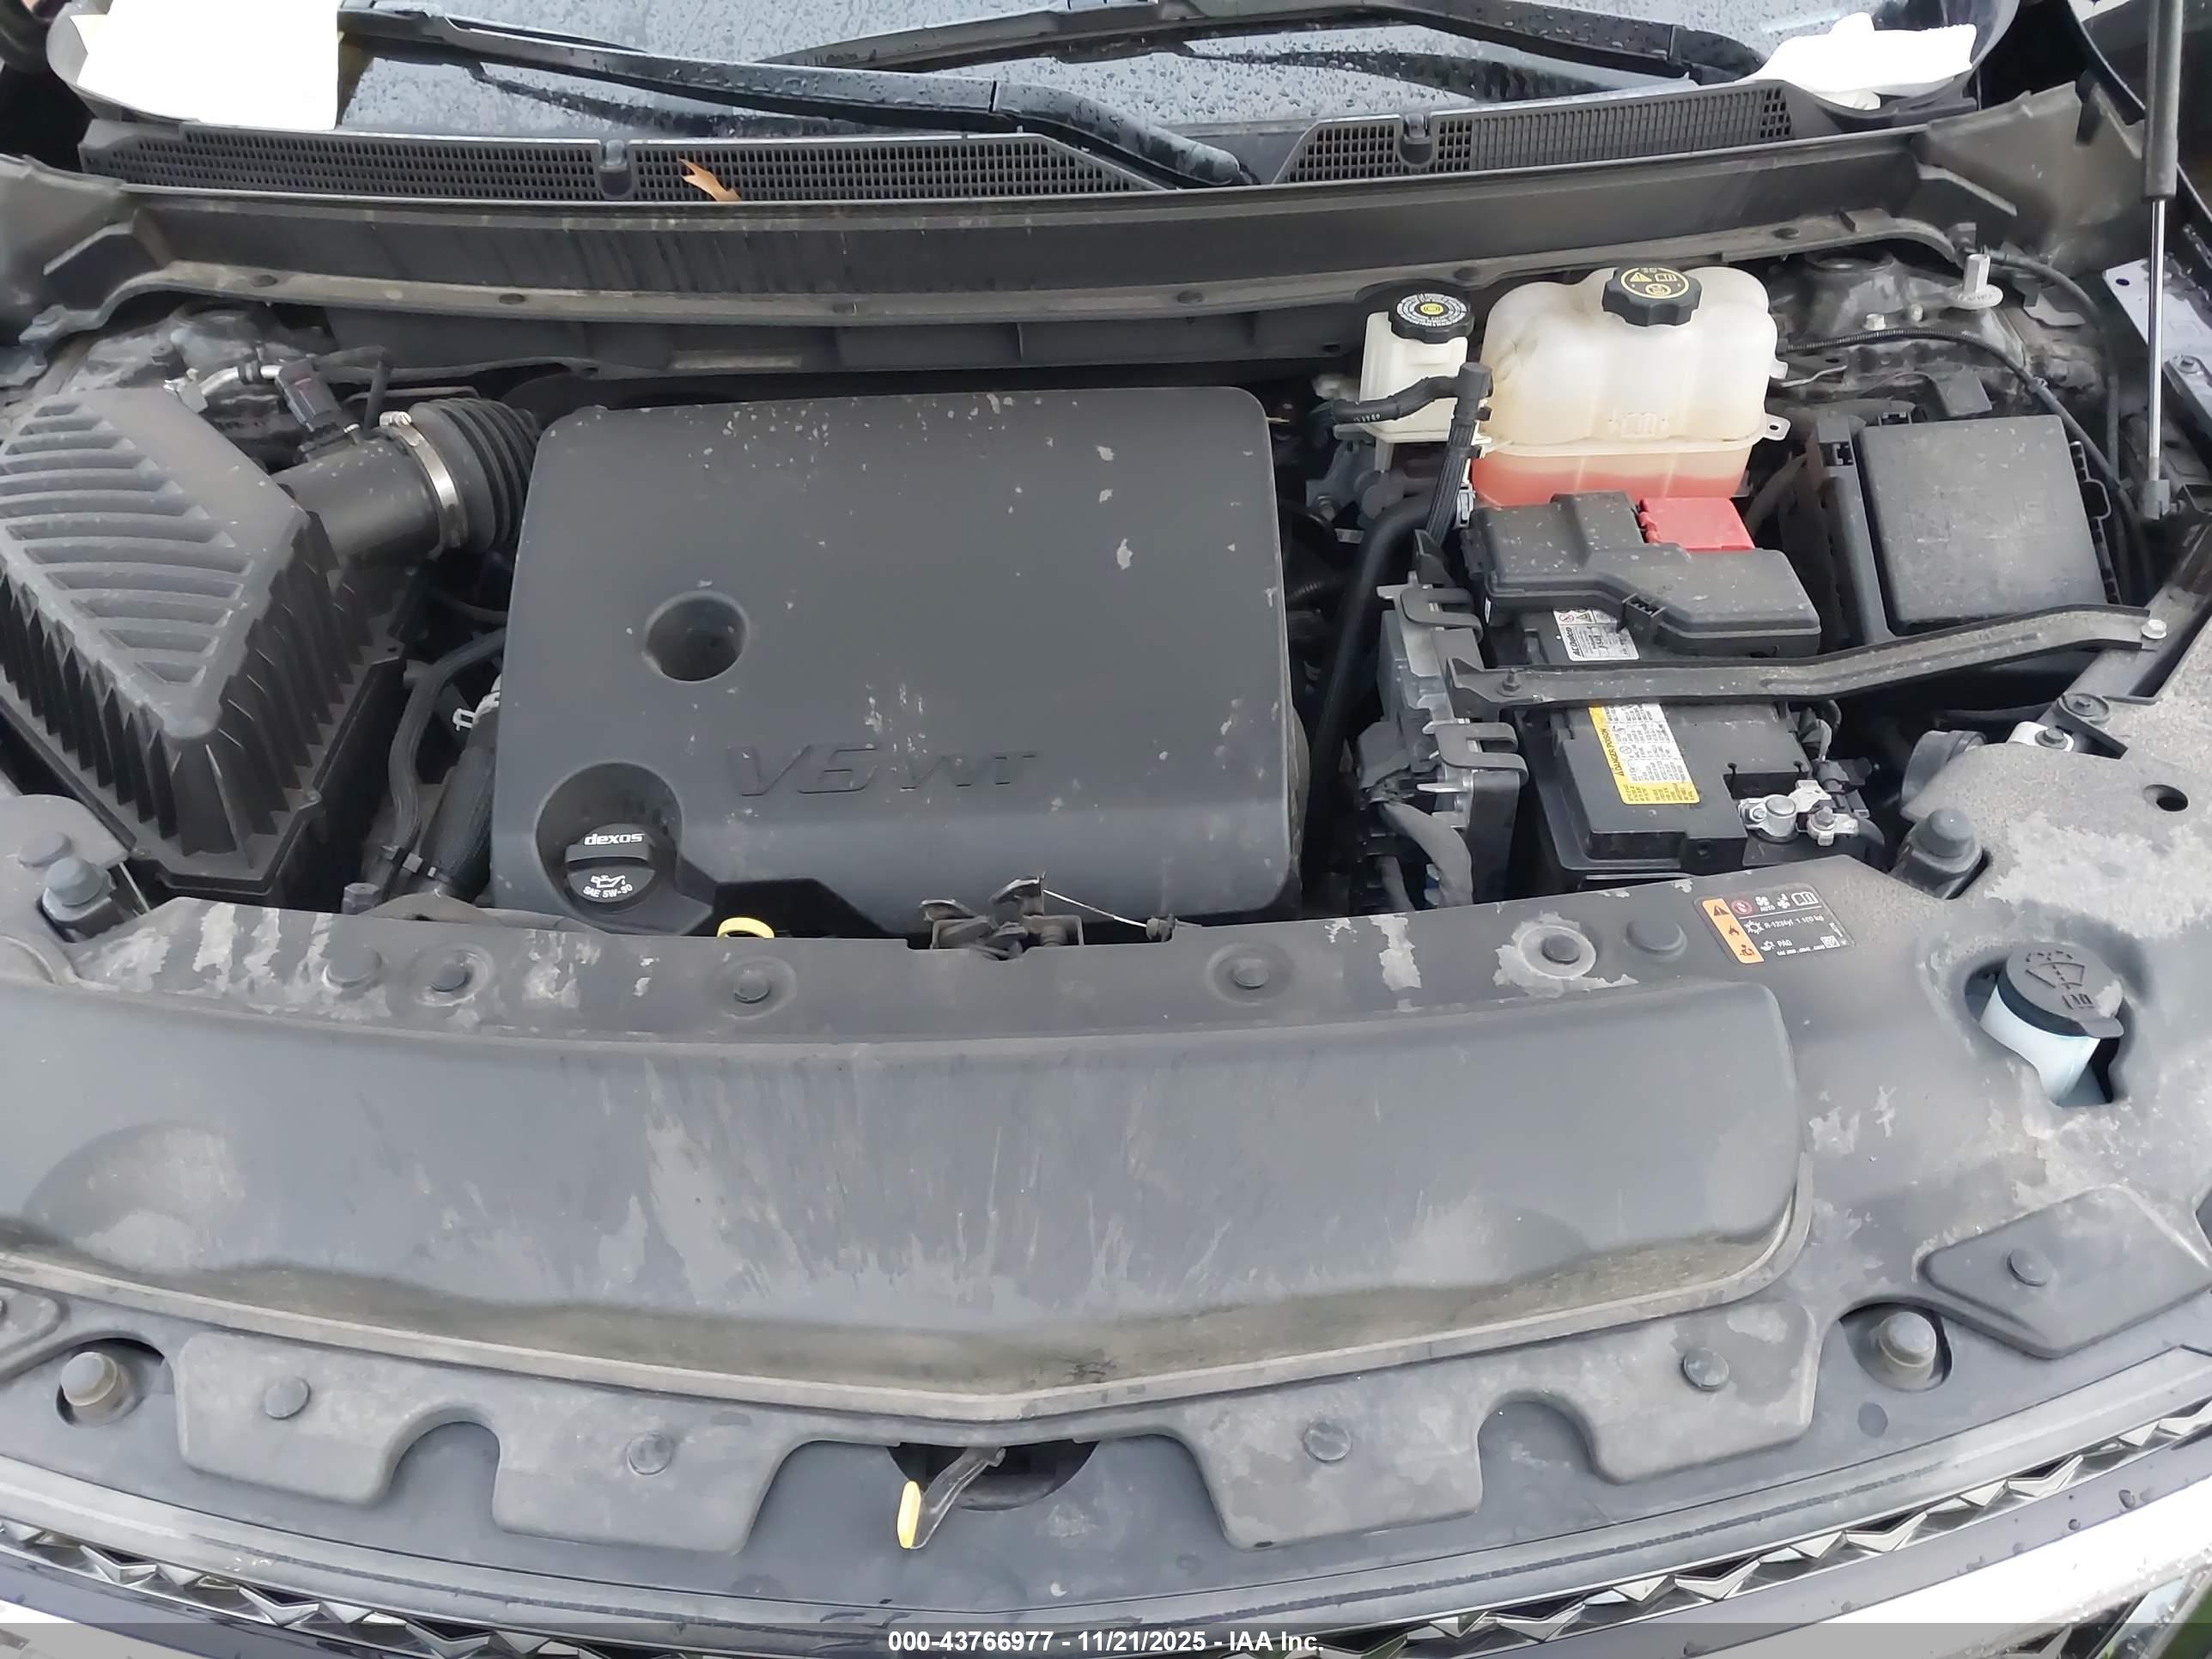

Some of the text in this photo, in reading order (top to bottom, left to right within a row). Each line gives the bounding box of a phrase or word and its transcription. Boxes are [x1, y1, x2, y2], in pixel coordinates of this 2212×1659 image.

[1608, 749, 1622, 771] DANGER
[726, 744, 879, 797] V6
[584, 833, 645, 846] dexos
[582, 884, 633, 898] SAE 5W-30
